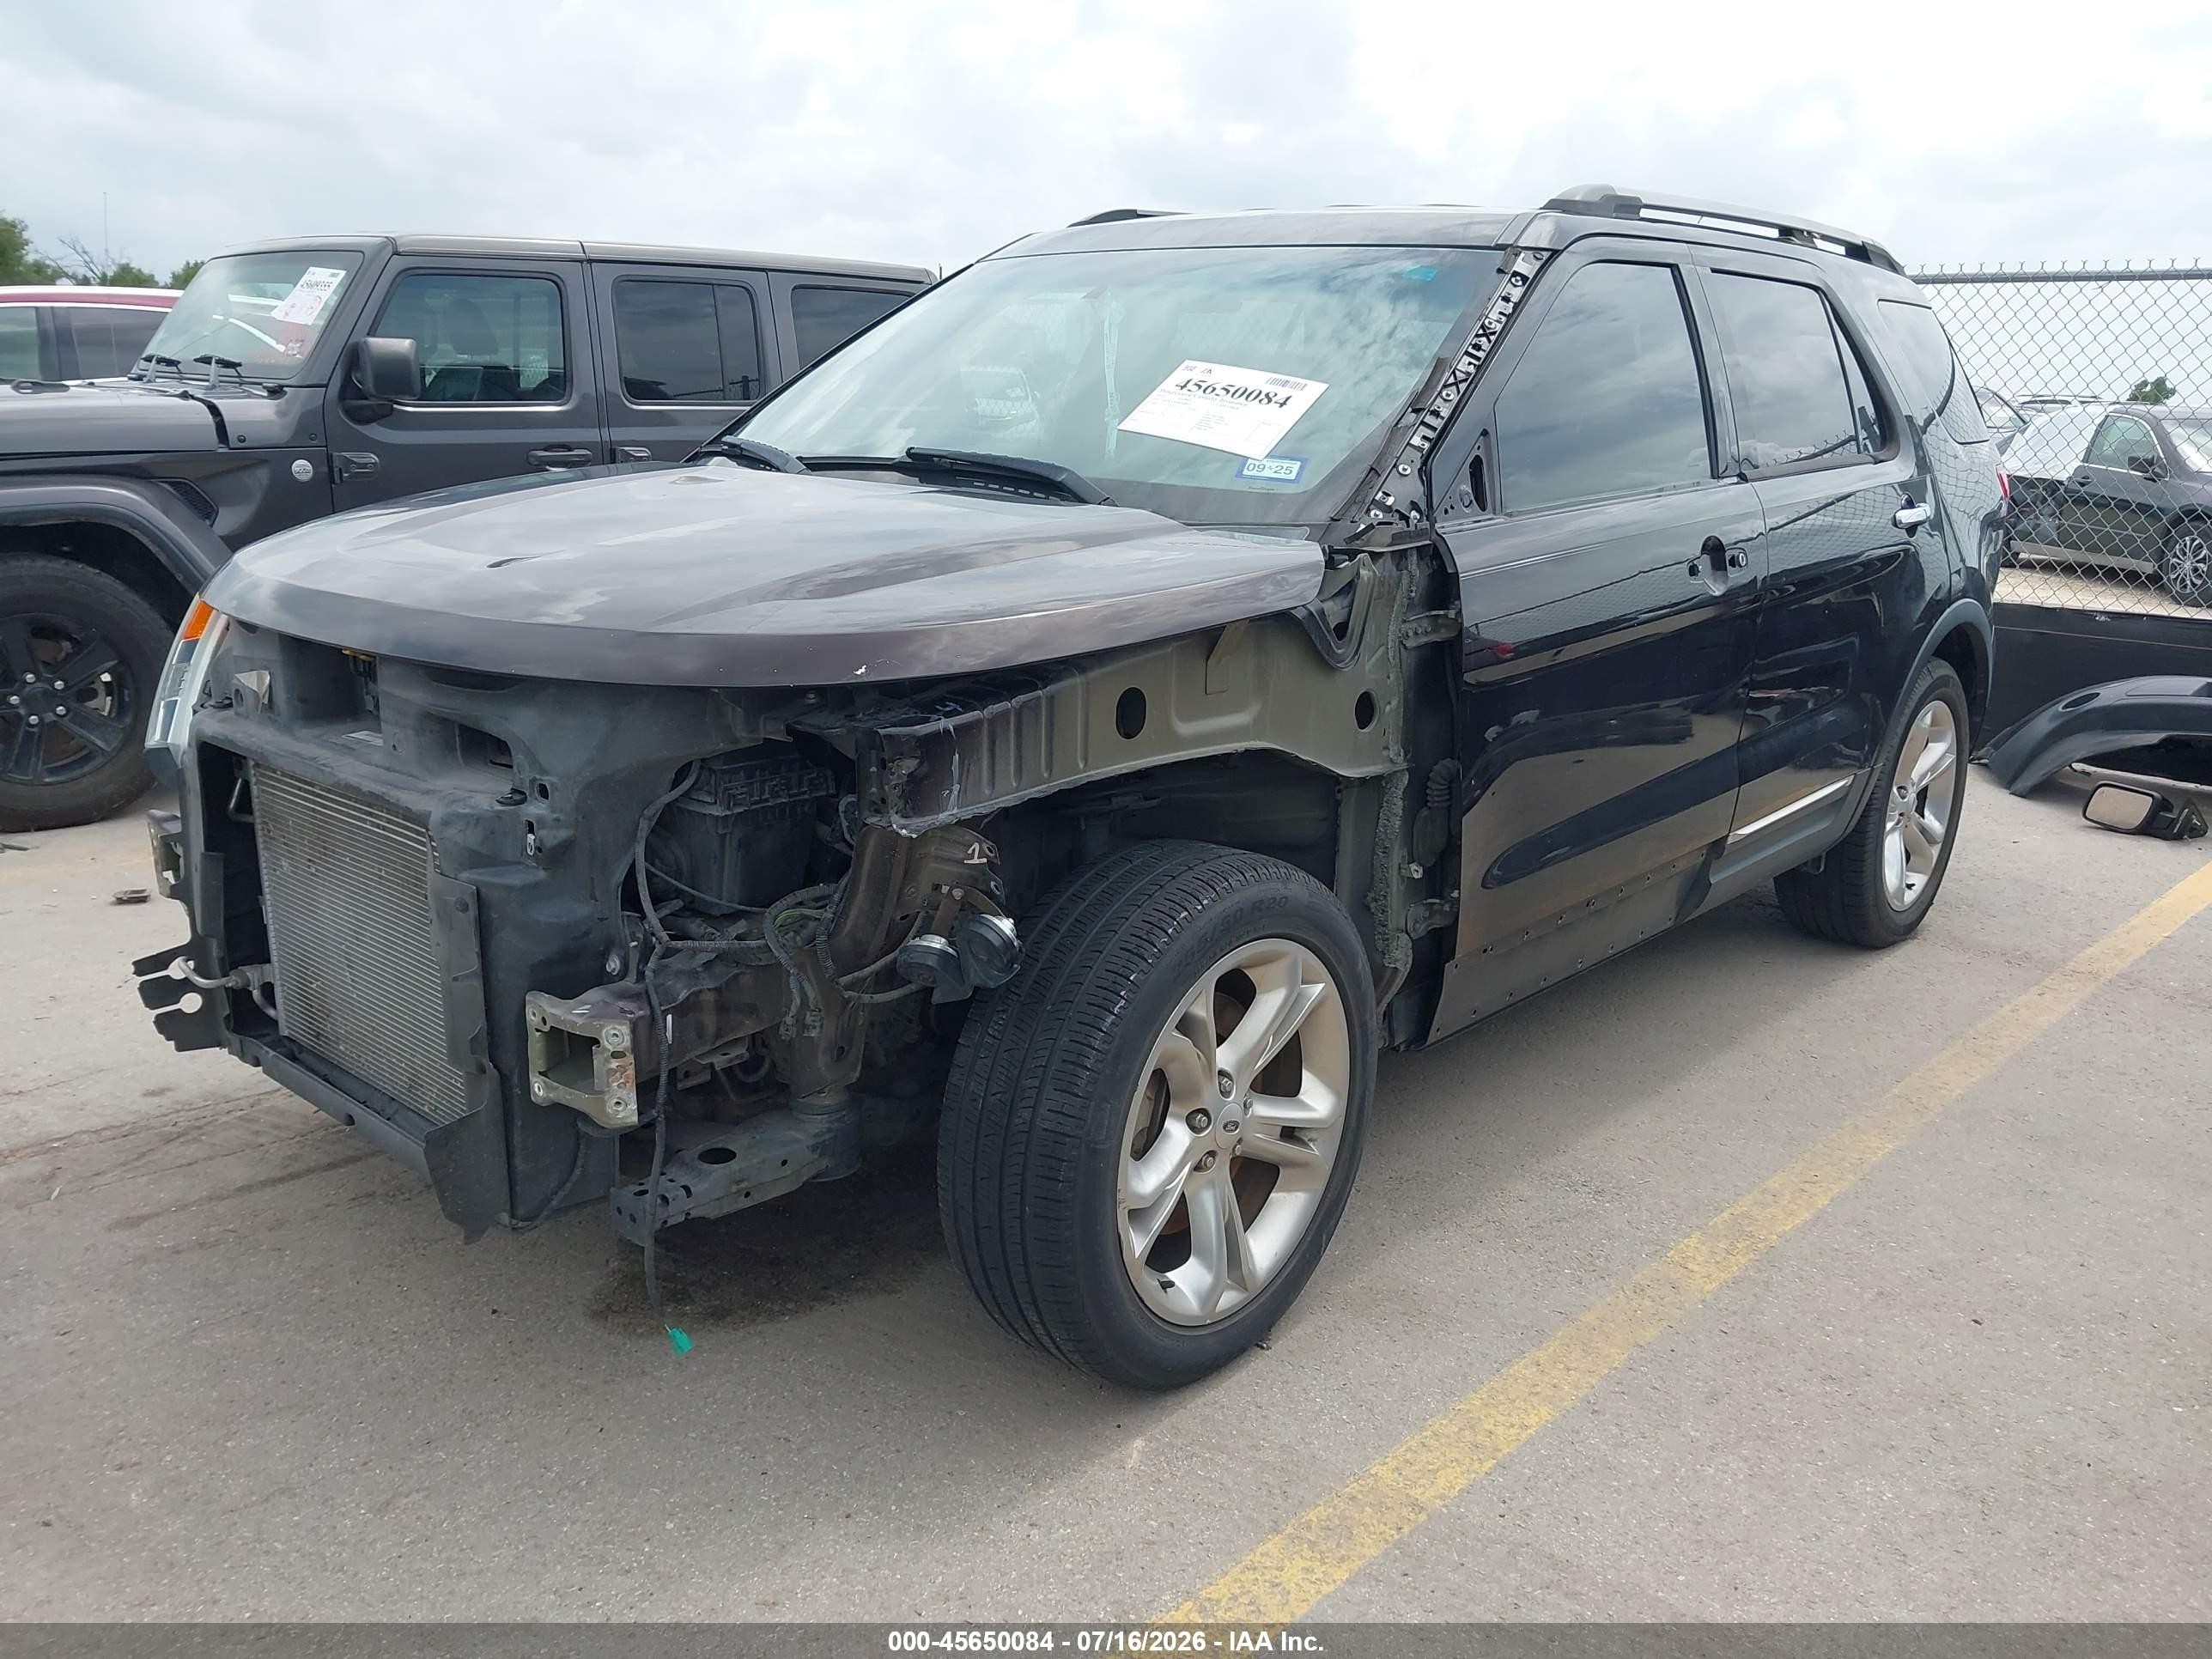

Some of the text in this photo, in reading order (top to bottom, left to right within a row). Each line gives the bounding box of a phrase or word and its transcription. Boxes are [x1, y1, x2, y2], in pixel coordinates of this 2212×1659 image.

[1175, 378, 1292, 408] 45650084
[1246, 462, 1267, 473] 09
[1249, 895, 1289, 915] R20
